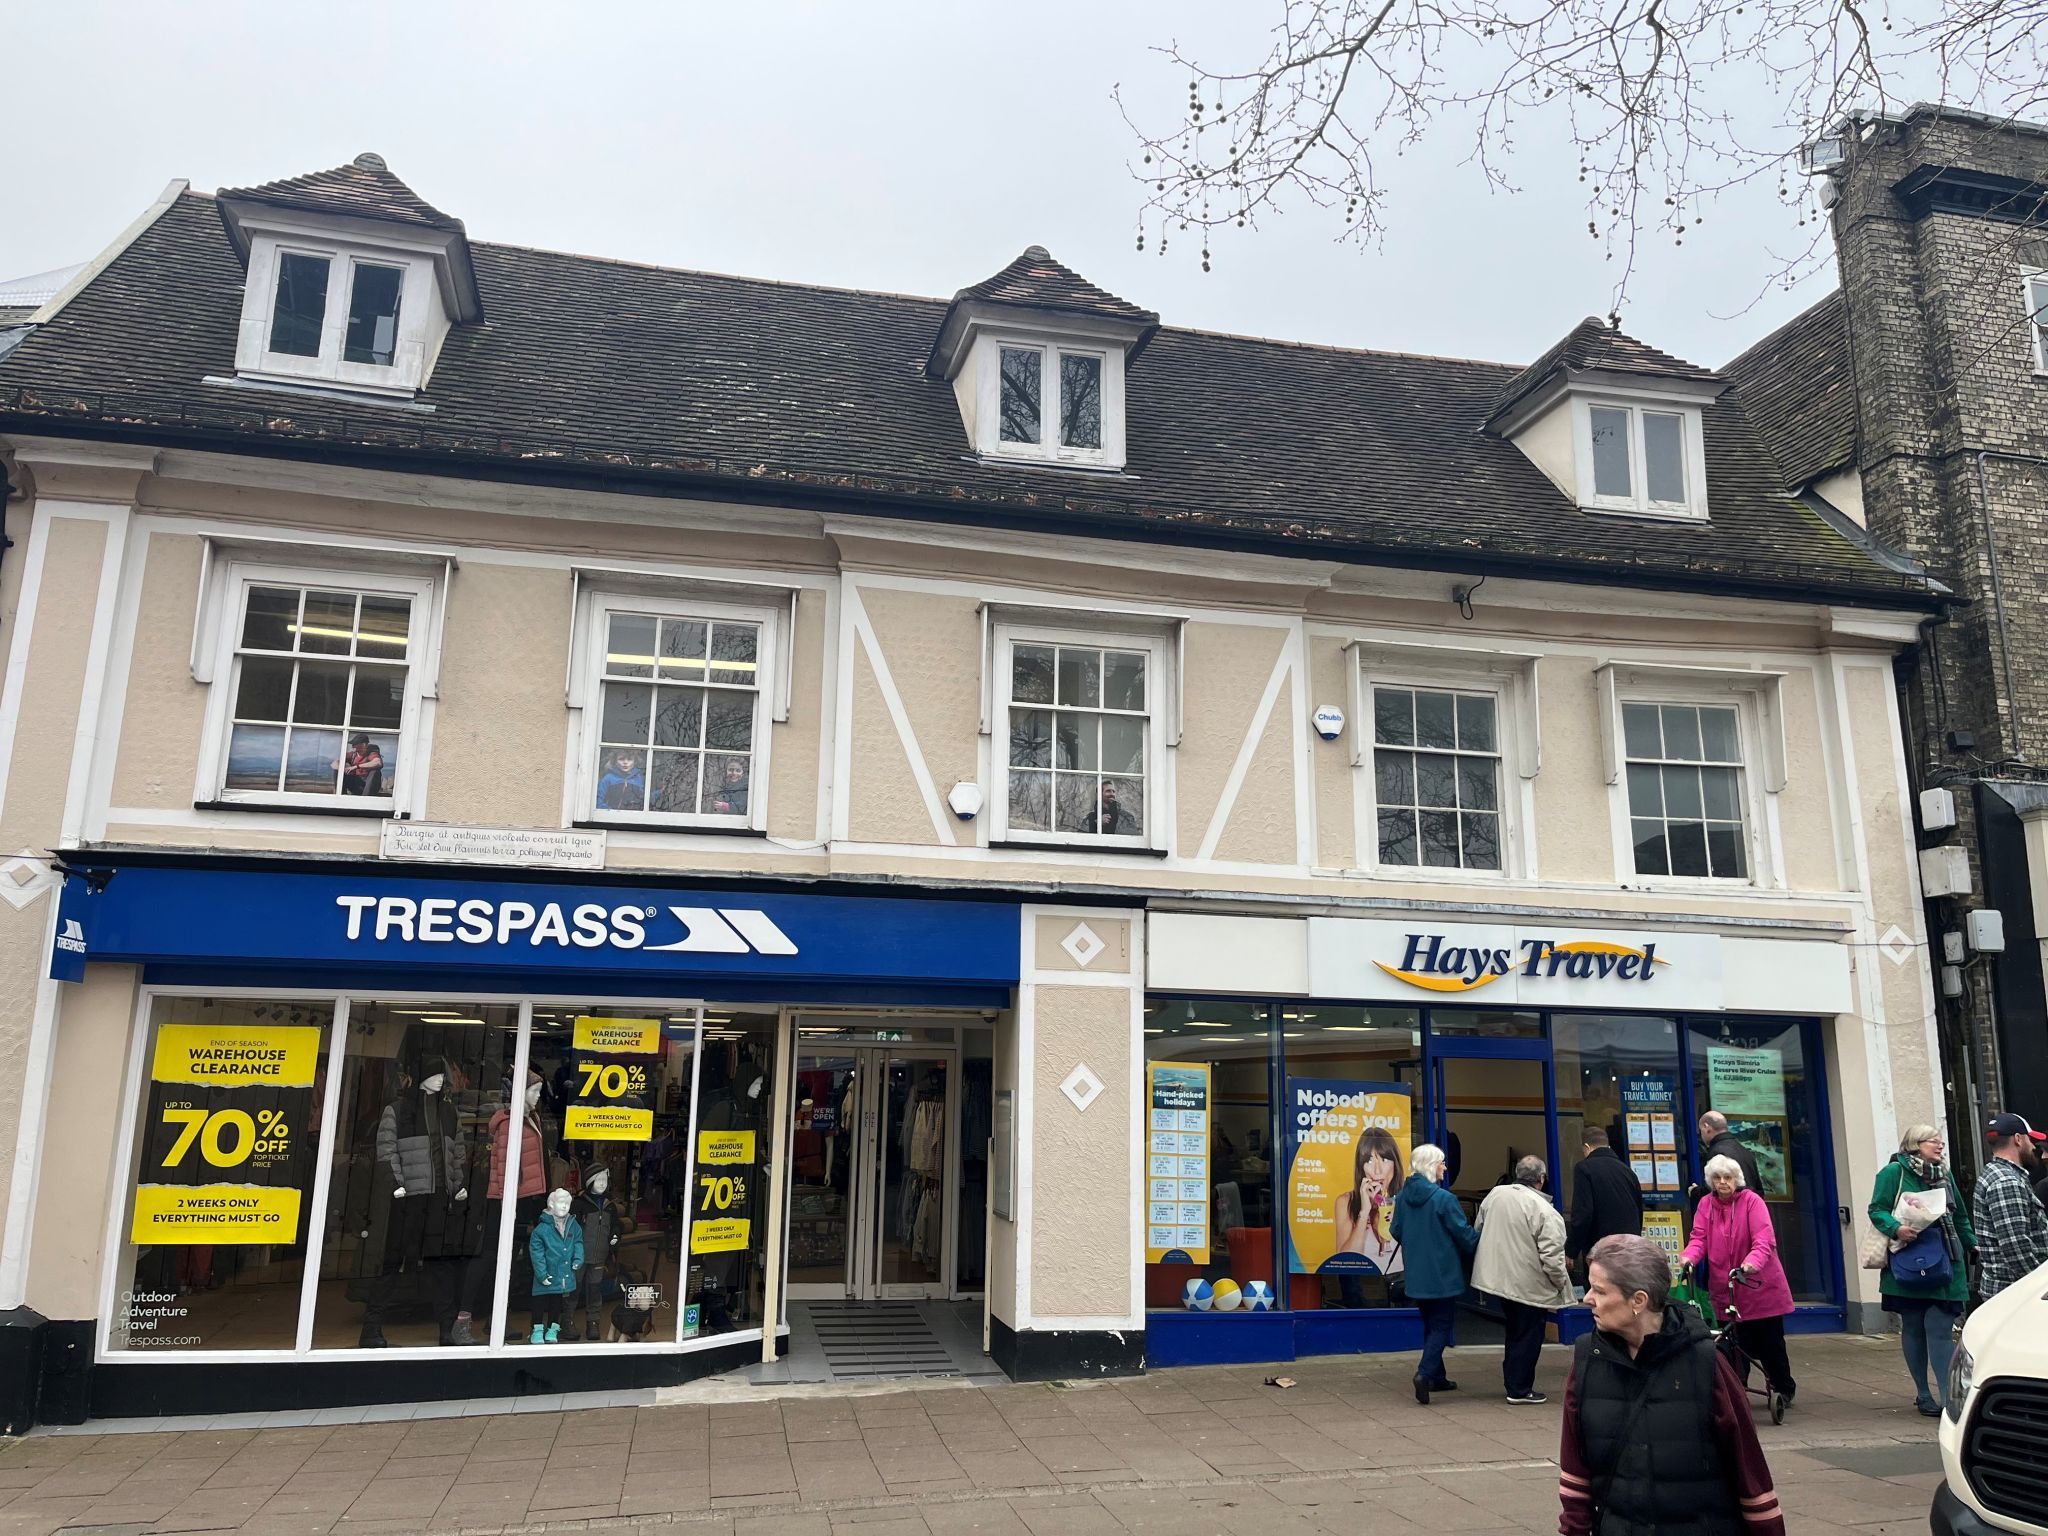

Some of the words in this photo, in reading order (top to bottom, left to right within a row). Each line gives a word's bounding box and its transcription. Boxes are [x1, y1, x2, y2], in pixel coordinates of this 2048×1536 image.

[1397, 933, 1511, 985] Hays
[1520, 939, 1657, 981] Travel
[591, 1030, 644, 1039] WAREHOUSE
[592, 1038, 640, 1047] CLEARANCE
[189, 1048, 286, 1061] WAREHOUSE
[190, 1063, 281, 1075] CLEARANCE
[628, 1082, 646, 1090] OFF
[1631, 1082, 1644, 1091] BUY
[1646, 1082, 1664, 1091] YOUR
[1156, 1090, 1204, 1099] Hand-picked
[1623, 1092, 1648, 1101] TRAVEL
[1649, 1092, 1672, 1101] MONEY
[165, 1101, 177, 1109] UP
[178, 1101, 192, 1109] TO
[1164, 1098, 1196, 1107] holidays
[1297, 1089, 1378, 1112] Nobody
[1297, 1108, 1358, 1128] offers
[1362, 1115, 1400, 1131] you
[1297, 1129, 1350, 1144] more
[1297, 1158, 1322, 1167] Save
[1297, 1183, 1320, 1192] Free
[178, 1199, 184, 1208] 2
[186, 1199, 226, 1208] WEEKS
[228, 1199, 260, 1208] ONLY
[1296, 1208, 1323, 1217] Book
[152, 1214, 226, 1223] EVERYTHING
[228, 1214, 261, 1223] MUST
[263, 1214, 280, 1223] GO
[697, 1234, 723, 1242] EVERYTHING
[121, 1291, 176, 1302] Outdoor
[120, 1306, 188, 1316] Adventure
[118, 1318, 158, 1330] Travel
[118, 1334, 201, 1348] Trespass.com
